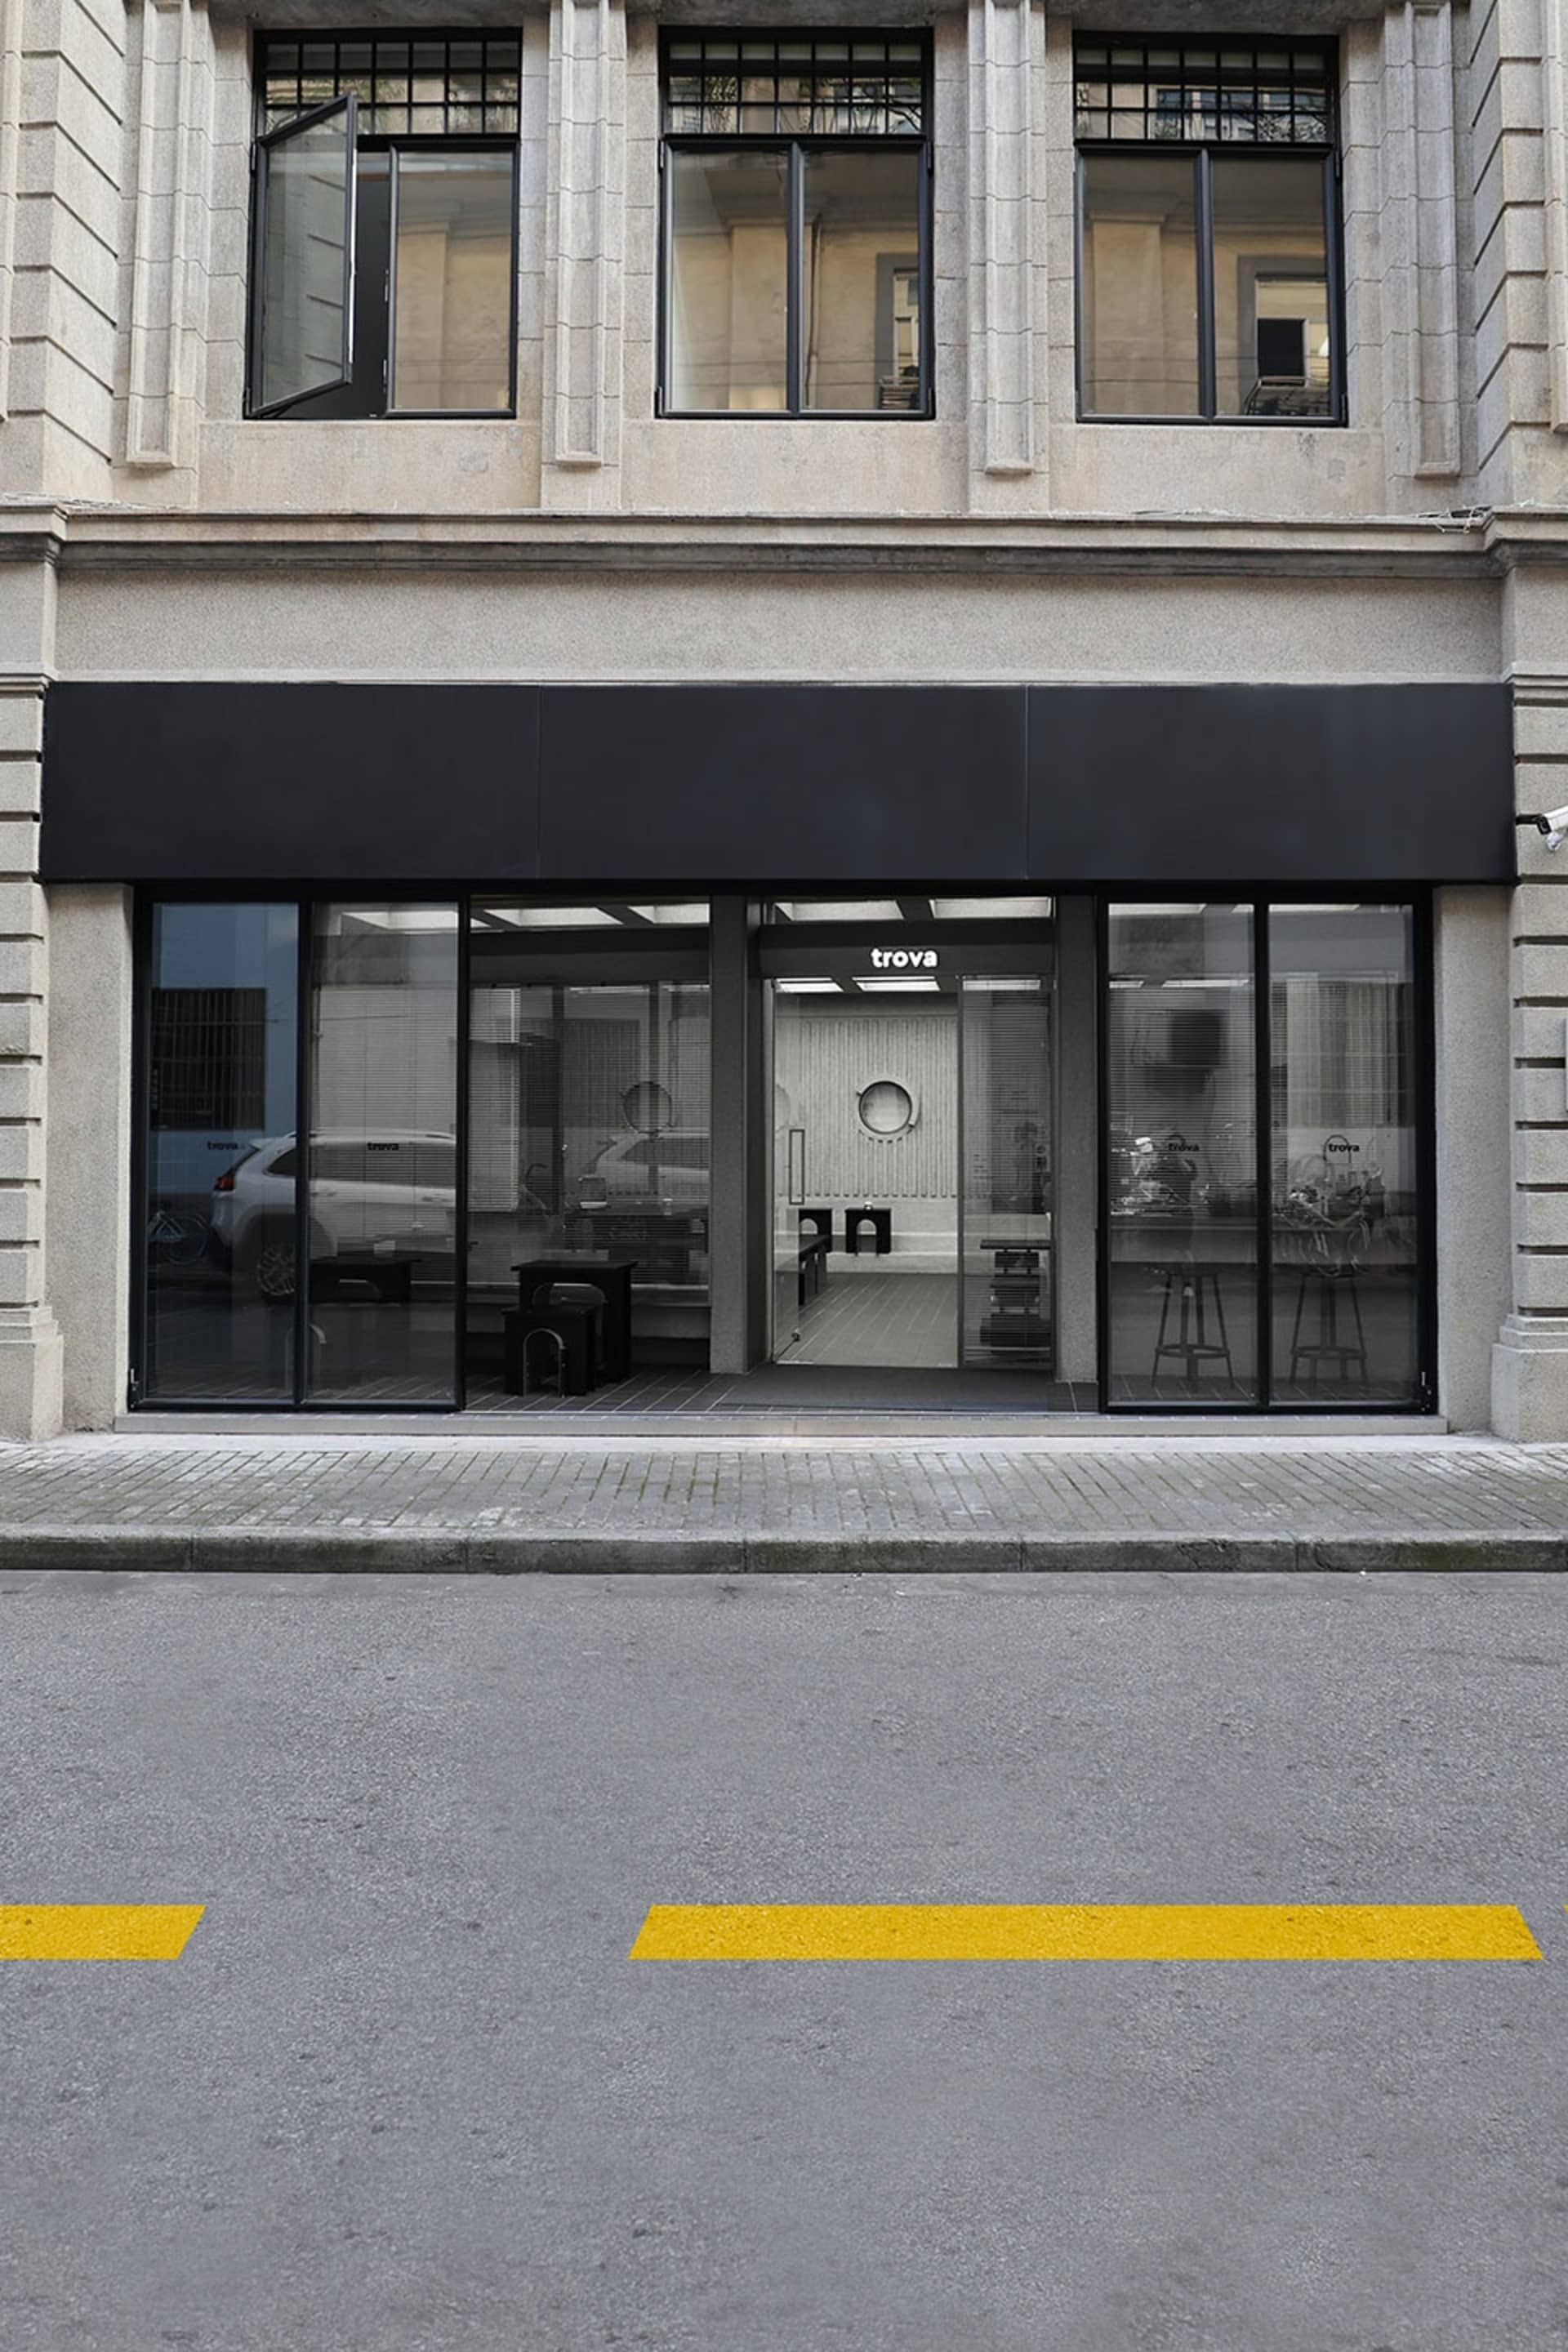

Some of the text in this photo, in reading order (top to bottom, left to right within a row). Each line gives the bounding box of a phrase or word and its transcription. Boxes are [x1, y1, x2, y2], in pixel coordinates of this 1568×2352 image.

[871, 948, 938, 968] trova
[367, 1142, 399, 1151] trova
[1329, 1143, 1360, 1152] trova
